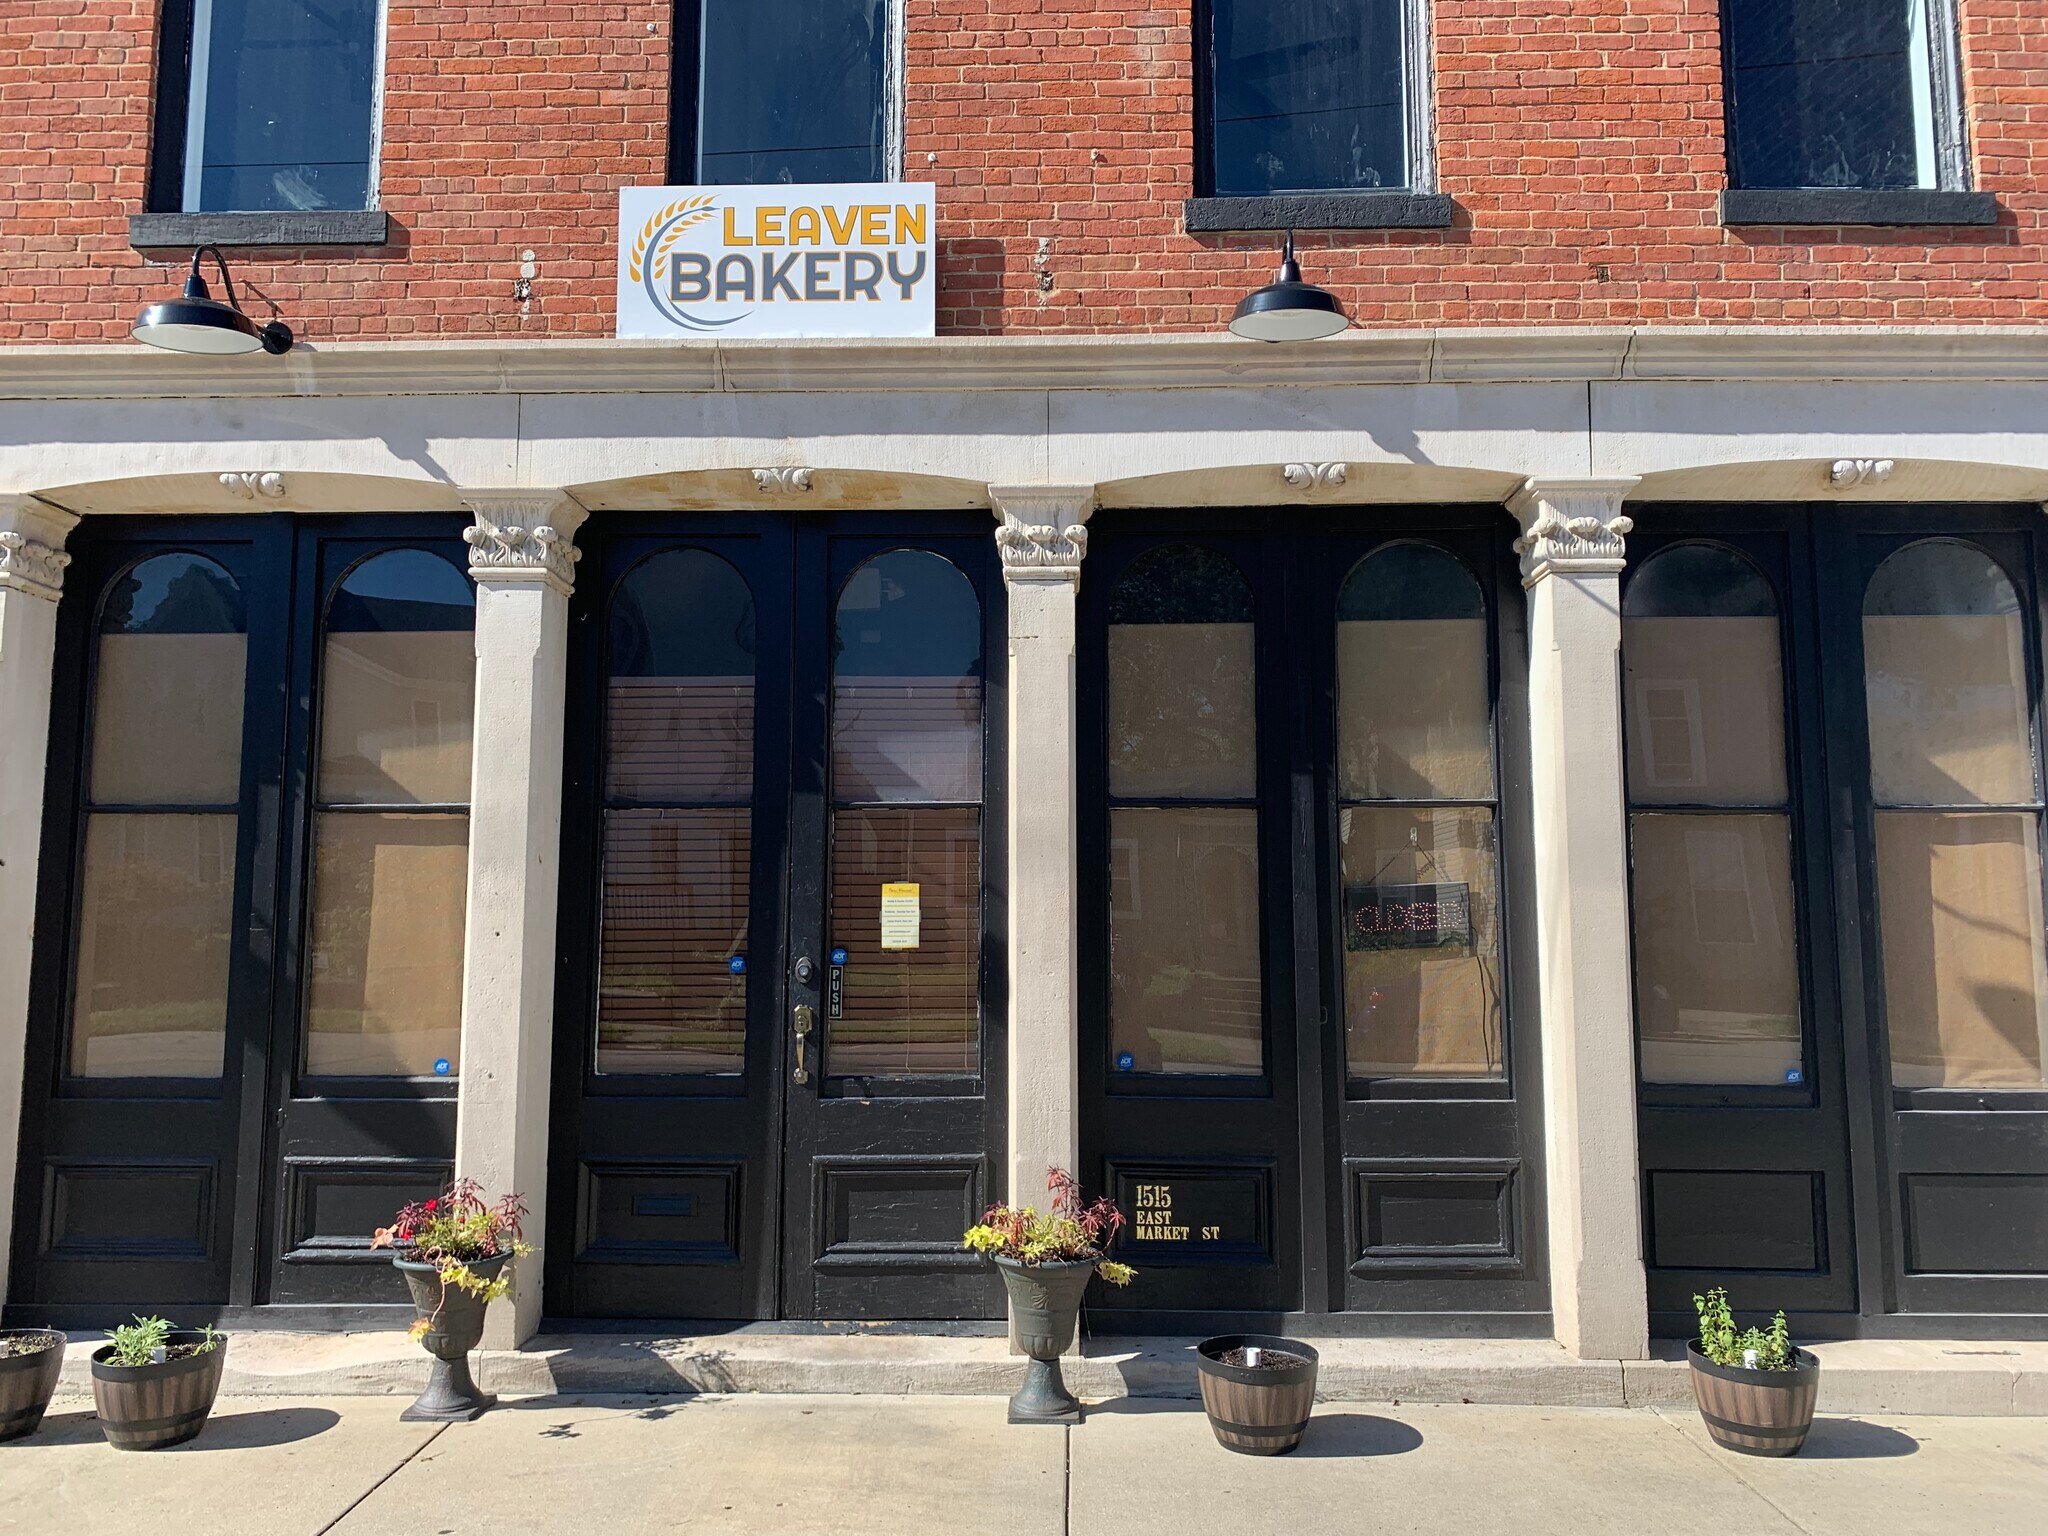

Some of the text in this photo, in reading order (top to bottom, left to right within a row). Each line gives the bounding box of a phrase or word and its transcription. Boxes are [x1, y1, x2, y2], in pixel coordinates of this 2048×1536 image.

[723, 204, 926, 246] LEAVEN
[670, 250, 927, 302] BAKERY
[831, 969, 840, 1015] PUSH
[1136, 1185, 1171, 1207] 1515
[1136, 1211, 1171, 1225] EAST
[1136, 1226, 1219, 1240] MARKET ST
